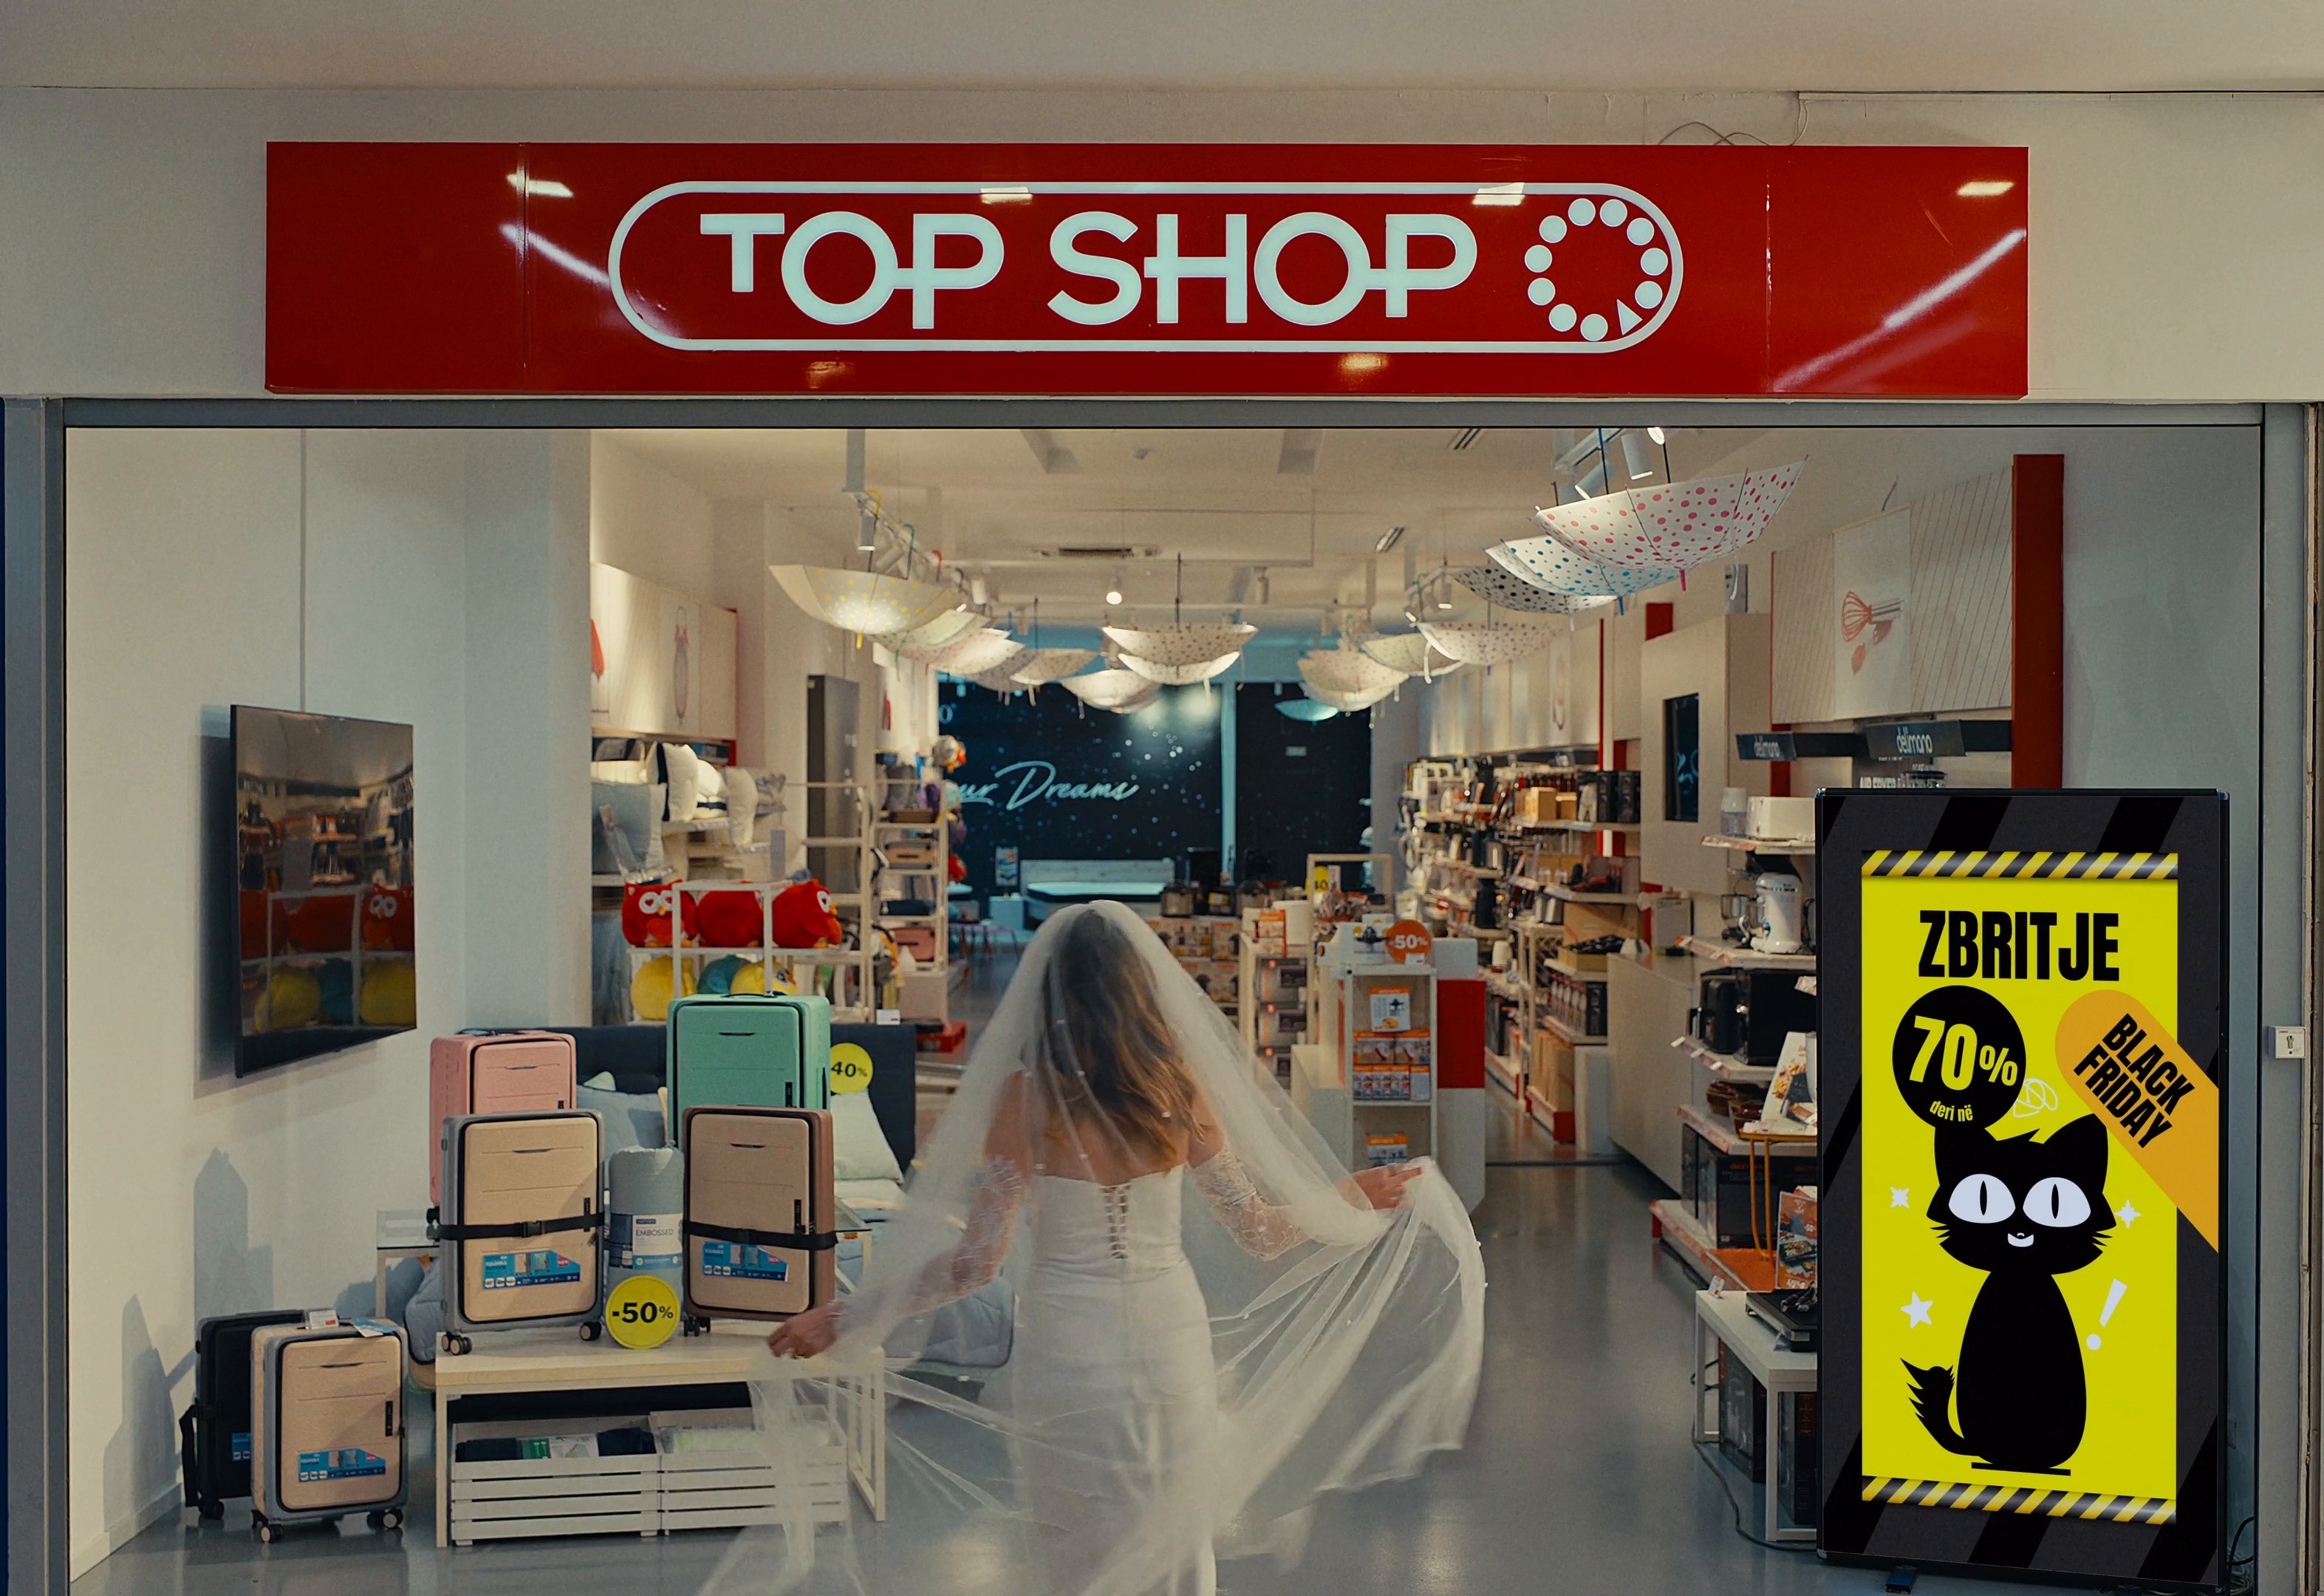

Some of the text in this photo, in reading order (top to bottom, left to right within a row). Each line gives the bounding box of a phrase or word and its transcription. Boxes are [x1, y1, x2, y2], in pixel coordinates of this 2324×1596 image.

[700, 211, 1477, 330] TOP SHOP
[995, 760, 1140, 811] Dreams
[1389, 933, 1429, 949] -50%
[1918, 910, 2119, 981] ZBRITJE
[1909, 1015, 2018, 1091] 70%
[2102, 1013, 2195, 1116] BLACK
[1930, 1100, 1973, 1122] deri në
[2074, 1043, 2173, 1148] FRIDAY
[636, 1228, 674, 1236] EMBOSSED
[612, 1302, 674, 1323] -50%
